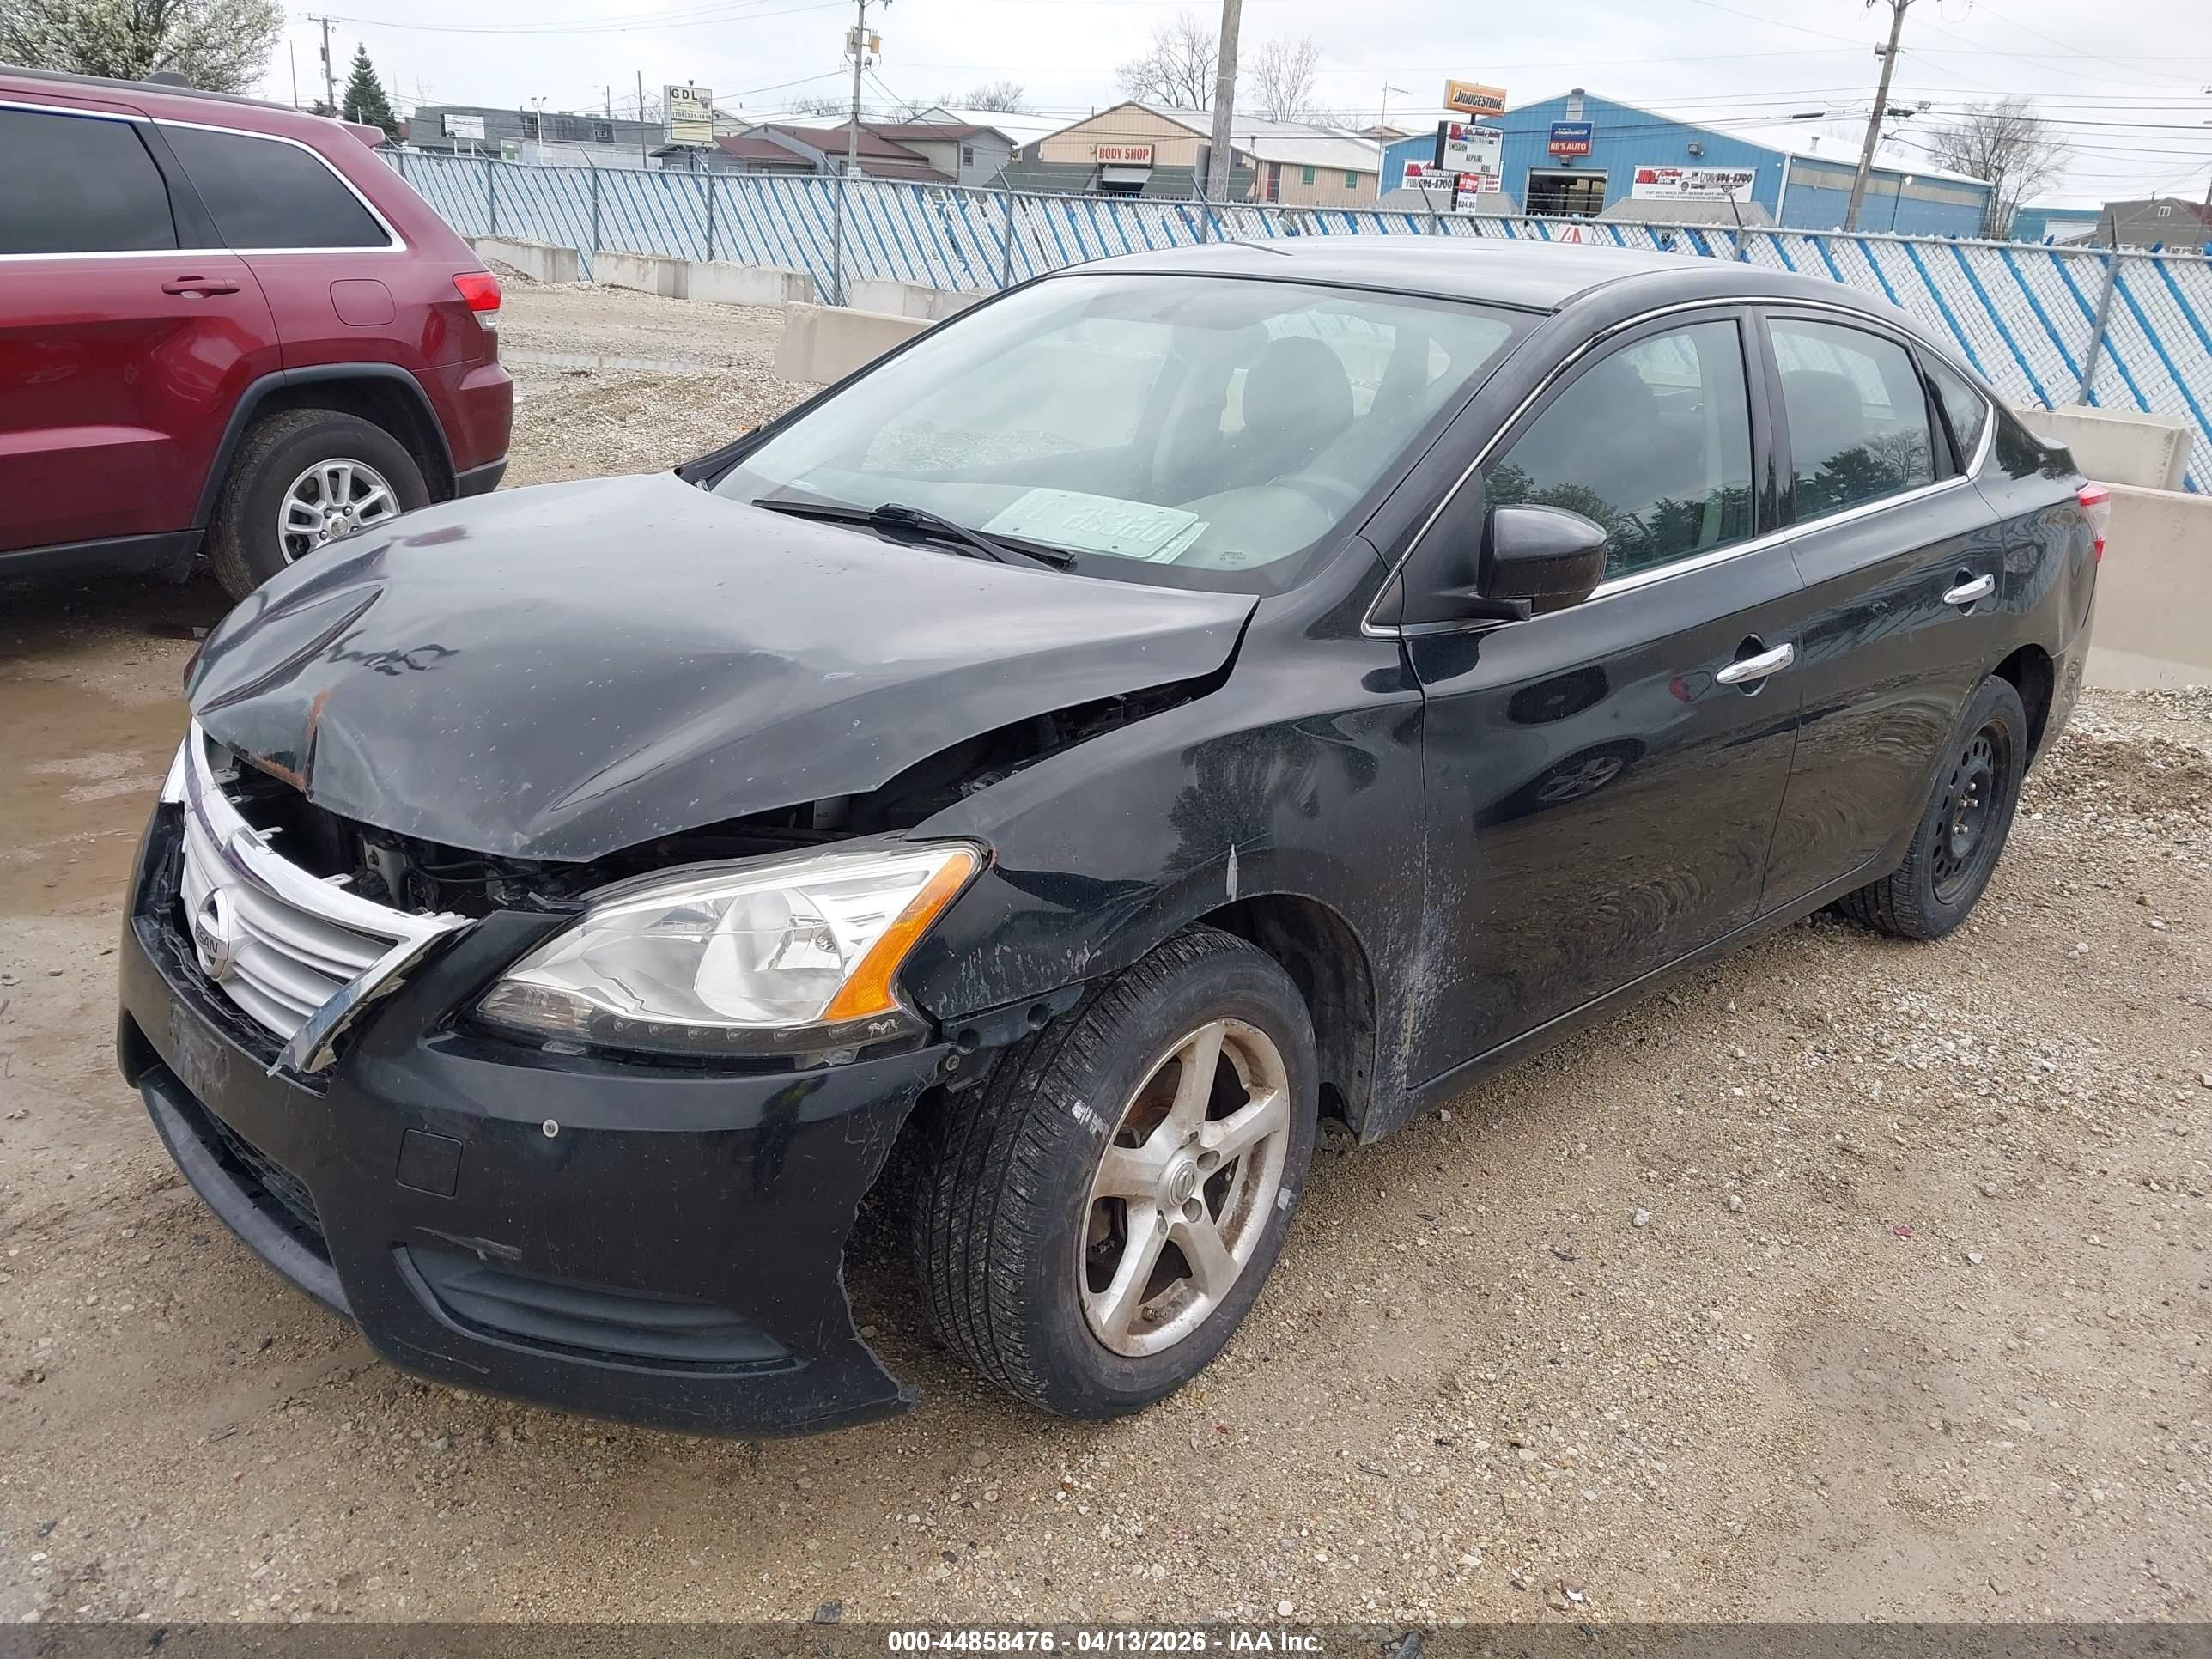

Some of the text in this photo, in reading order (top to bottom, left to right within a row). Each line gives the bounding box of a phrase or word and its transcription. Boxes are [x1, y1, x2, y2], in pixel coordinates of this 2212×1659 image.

[672, 88, 698, 100] GDL
[1453, 88, 1504, 110] BRIDGESTONE
[1550, 143, 1587, 151] RB'S AUTO
[1099, 147, 1149, 161] BODY SHOP
[1466, 154, 1483, 163] REPAIRS
